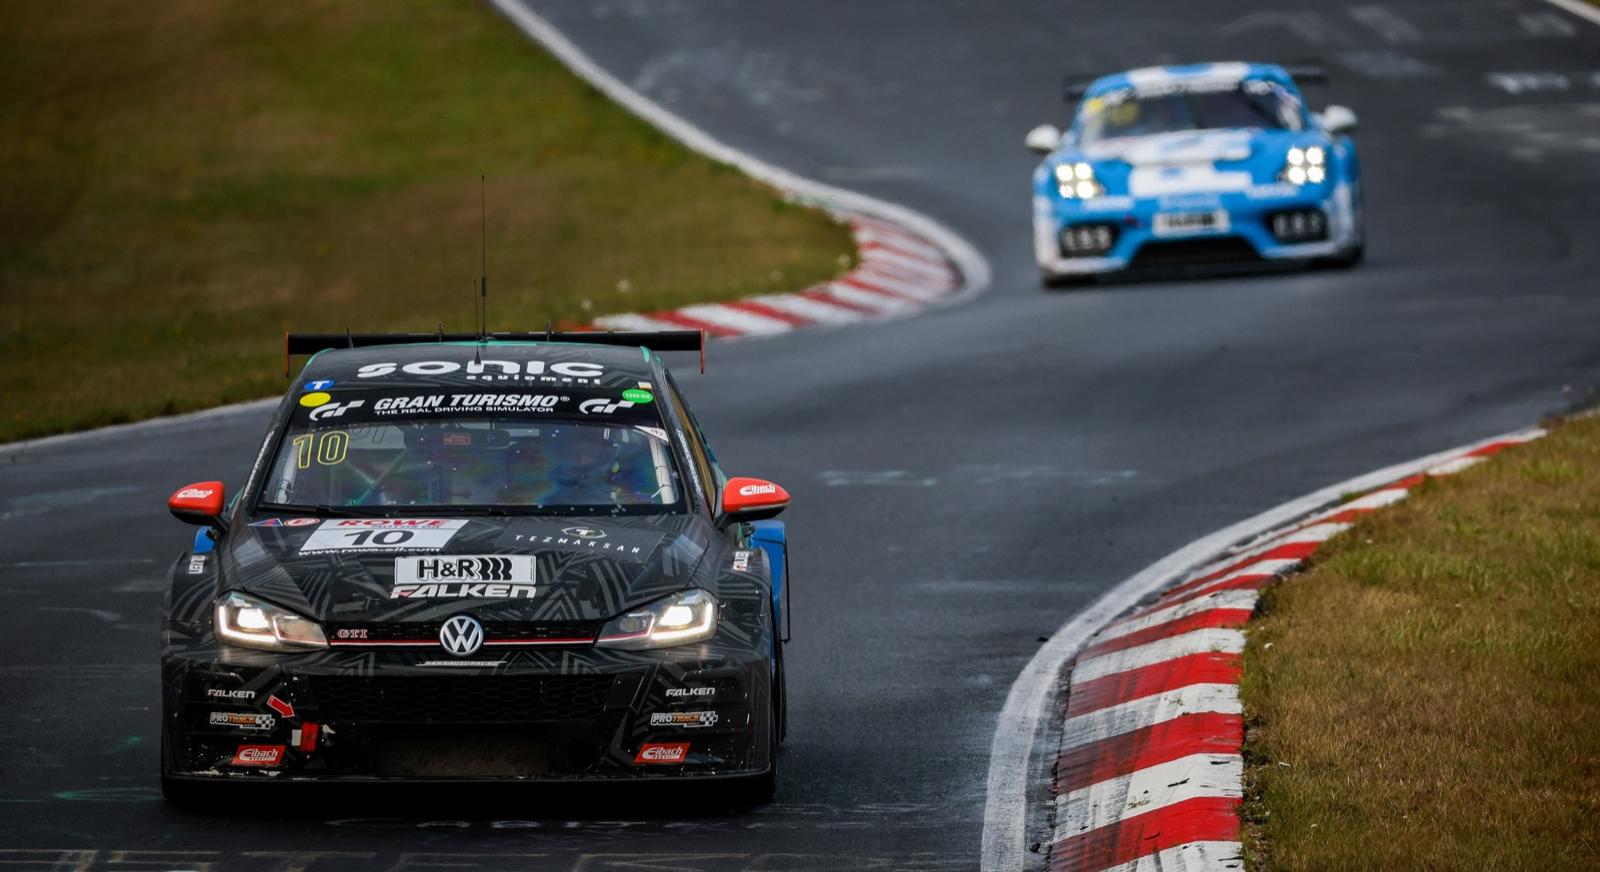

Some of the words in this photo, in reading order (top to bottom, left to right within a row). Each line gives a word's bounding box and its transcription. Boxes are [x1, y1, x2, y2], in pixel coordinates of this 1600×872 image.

[357, 360, 604, 378] sonic
[374, 395, 446, 410] GRAN
[486, 405, 554, 413] SIMULATOR
[292, 430, 349, 469] 10
[337, 519, 448, 527] ROWE
[344, 530, 415, 546] 10
[515, 534, 640, 554] TEZMAKSAN
[417, 558, 481, 579] H&R
[390, 583, 537, 599] FALKEN
[336, 629, 368, 639] GTI
[207, 689, 256, 699] FALKEN
[665, 687, 716, 696] FALKEN
[239, 747, 278, 761] Eibach
[642, 745, 683, 760] Eibach
